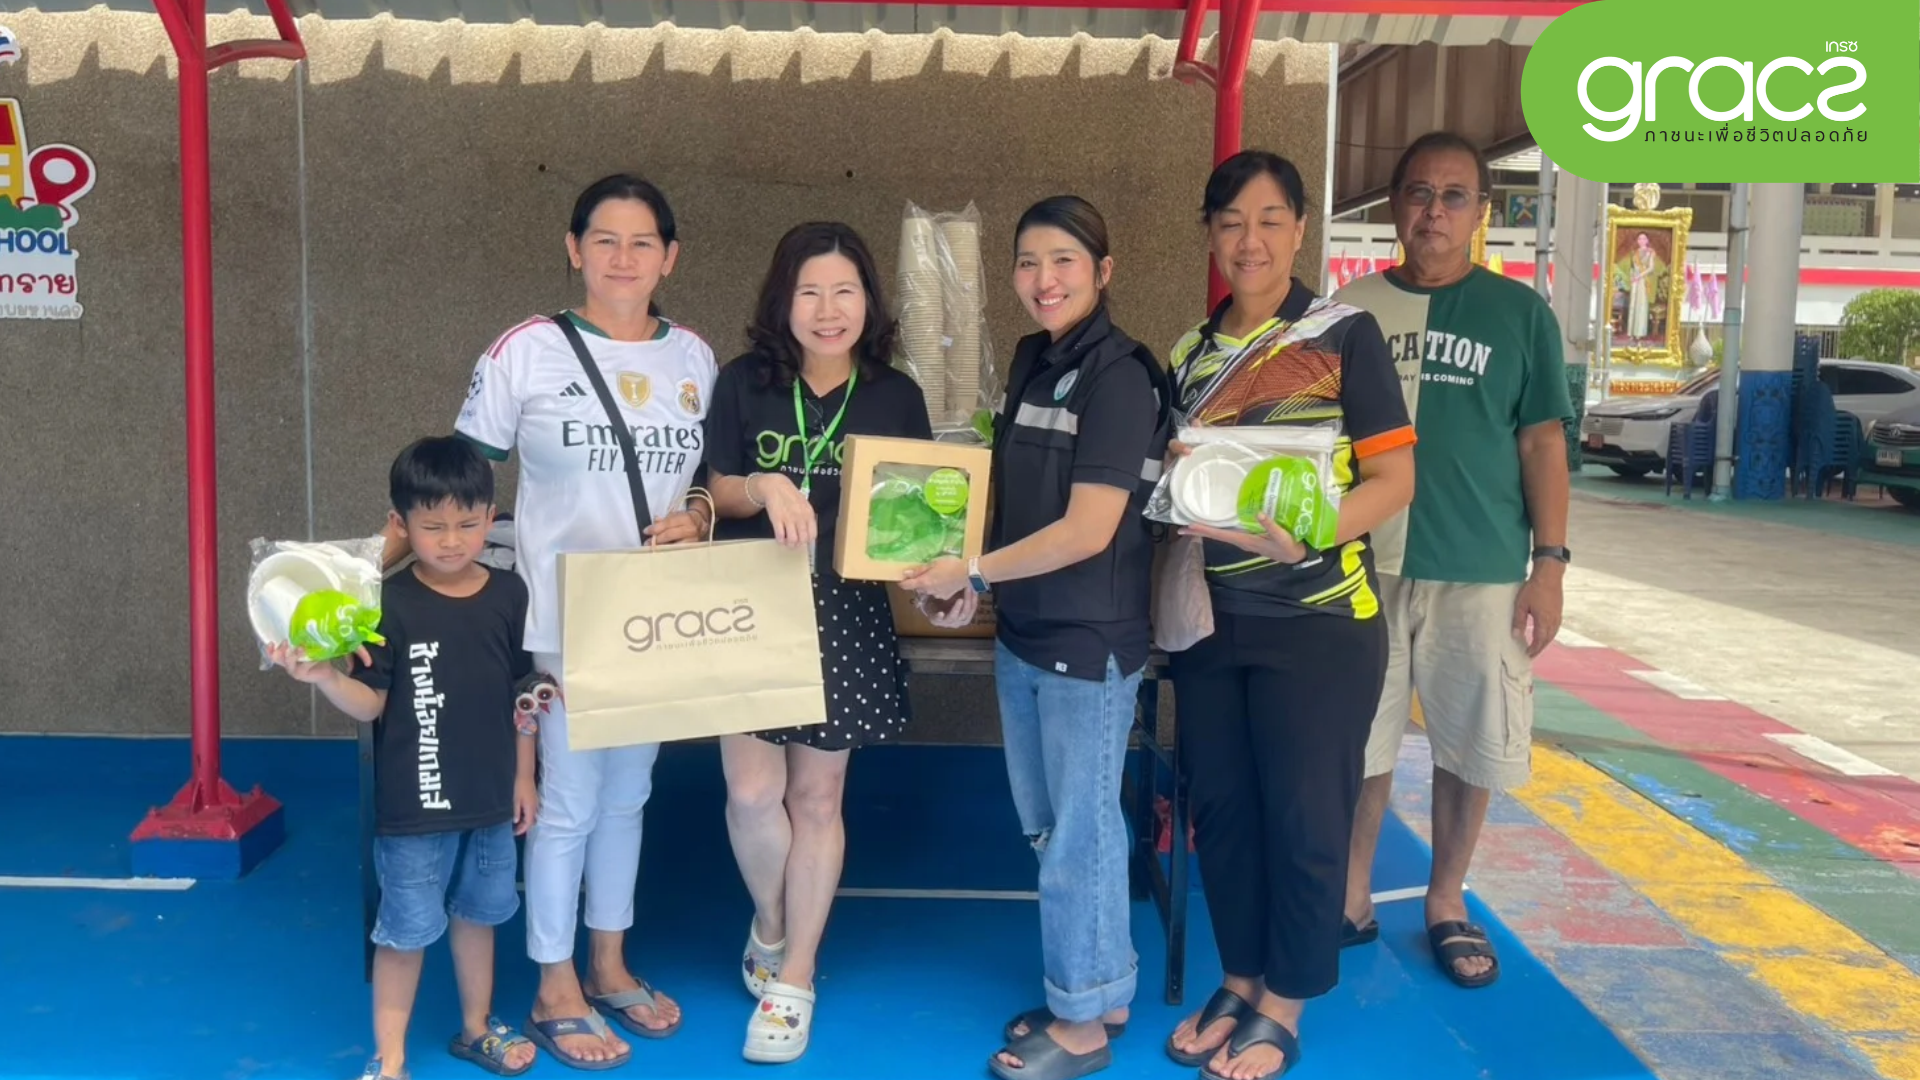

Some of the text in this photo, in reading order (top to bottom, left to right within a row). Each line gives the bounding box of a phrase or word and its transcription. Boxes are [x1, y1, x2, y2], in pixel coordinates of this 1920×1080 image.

[1420, 373, 1432, 382] IS
[1433, 374, 1474, 386] COMING
[562, 419, 700, 451] Emrates
[588, 448, 687, 475] FLY ETTER
